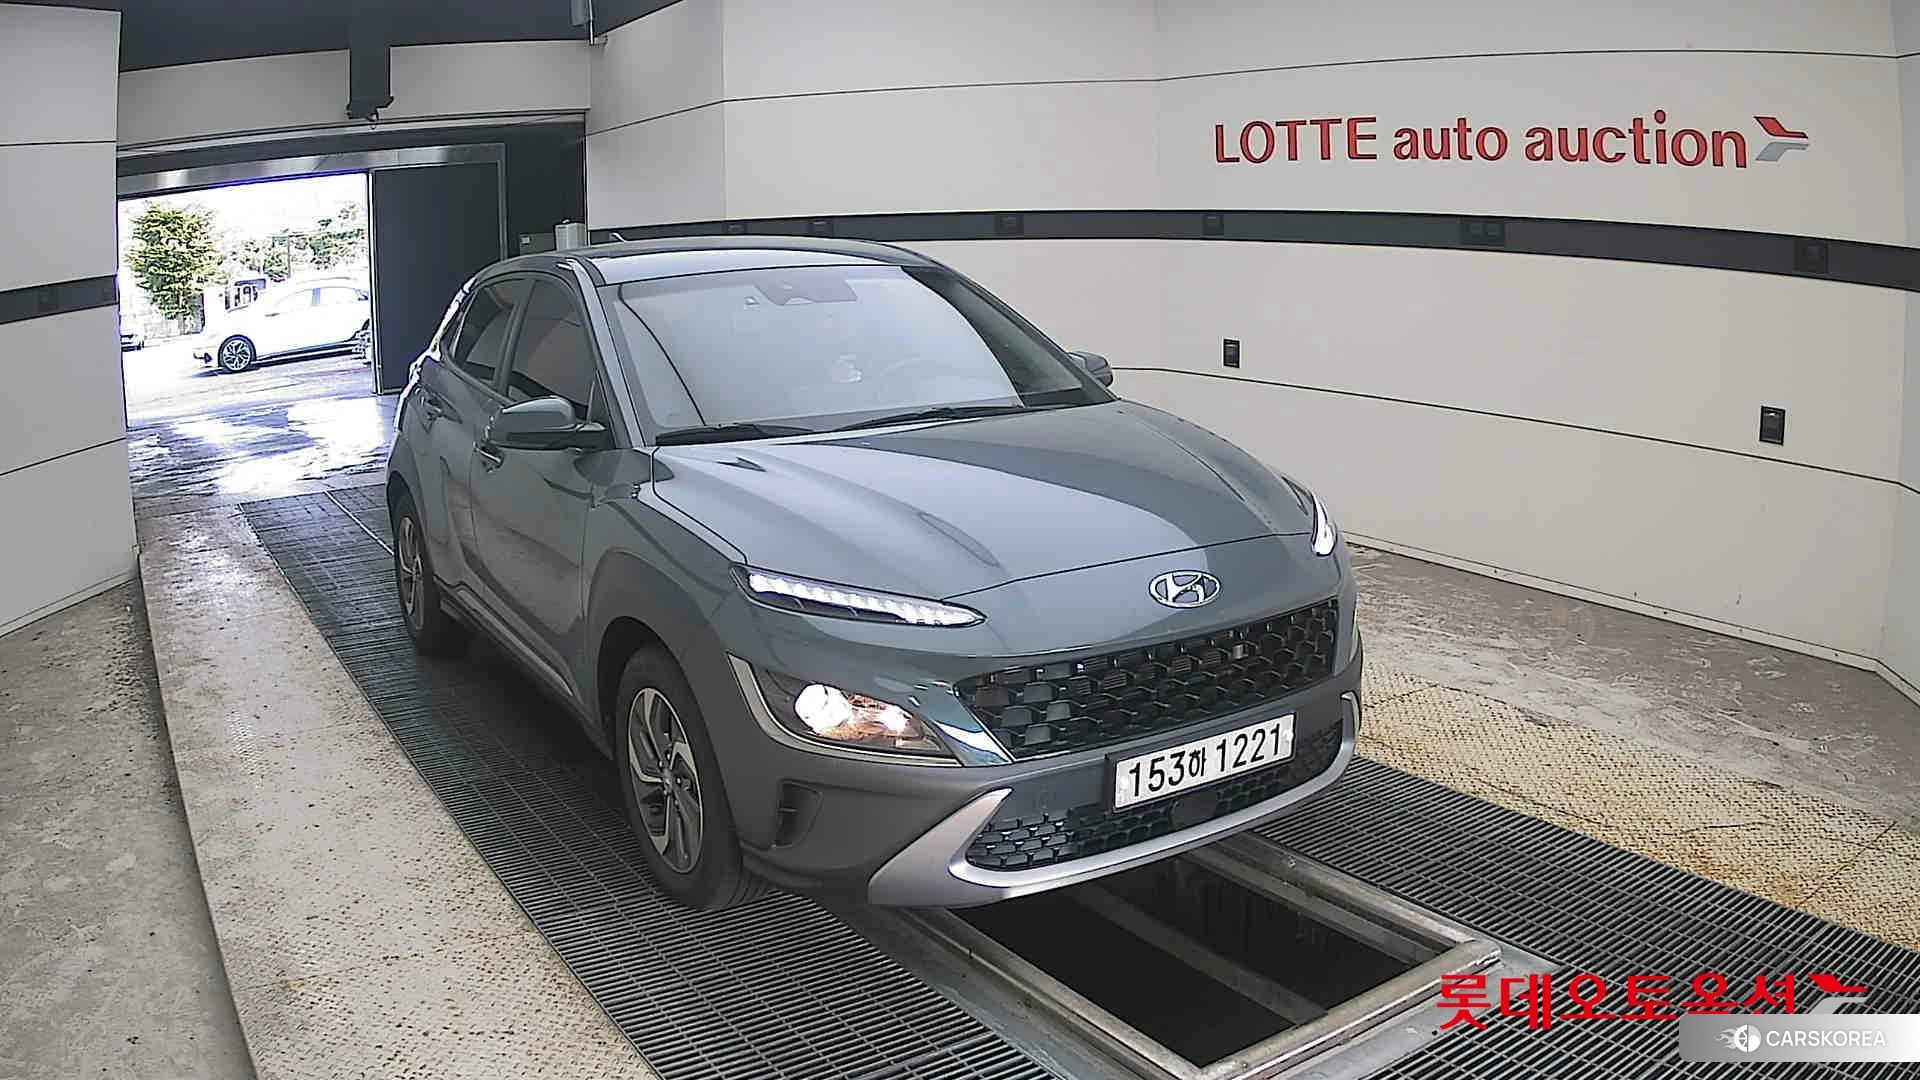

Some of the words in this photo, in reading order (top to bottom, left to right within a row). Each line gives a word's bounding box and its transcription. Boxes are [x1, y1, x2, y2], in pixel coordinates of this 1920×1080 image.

[1214, 116, 1378, 164] LOTTE
[1393, 117, 1508, 161] auto
[1524, 109, 1748, 169] auction
[1128, 746, 1207, 797] 153하
[1216, 723, 1280, 772] 1221
